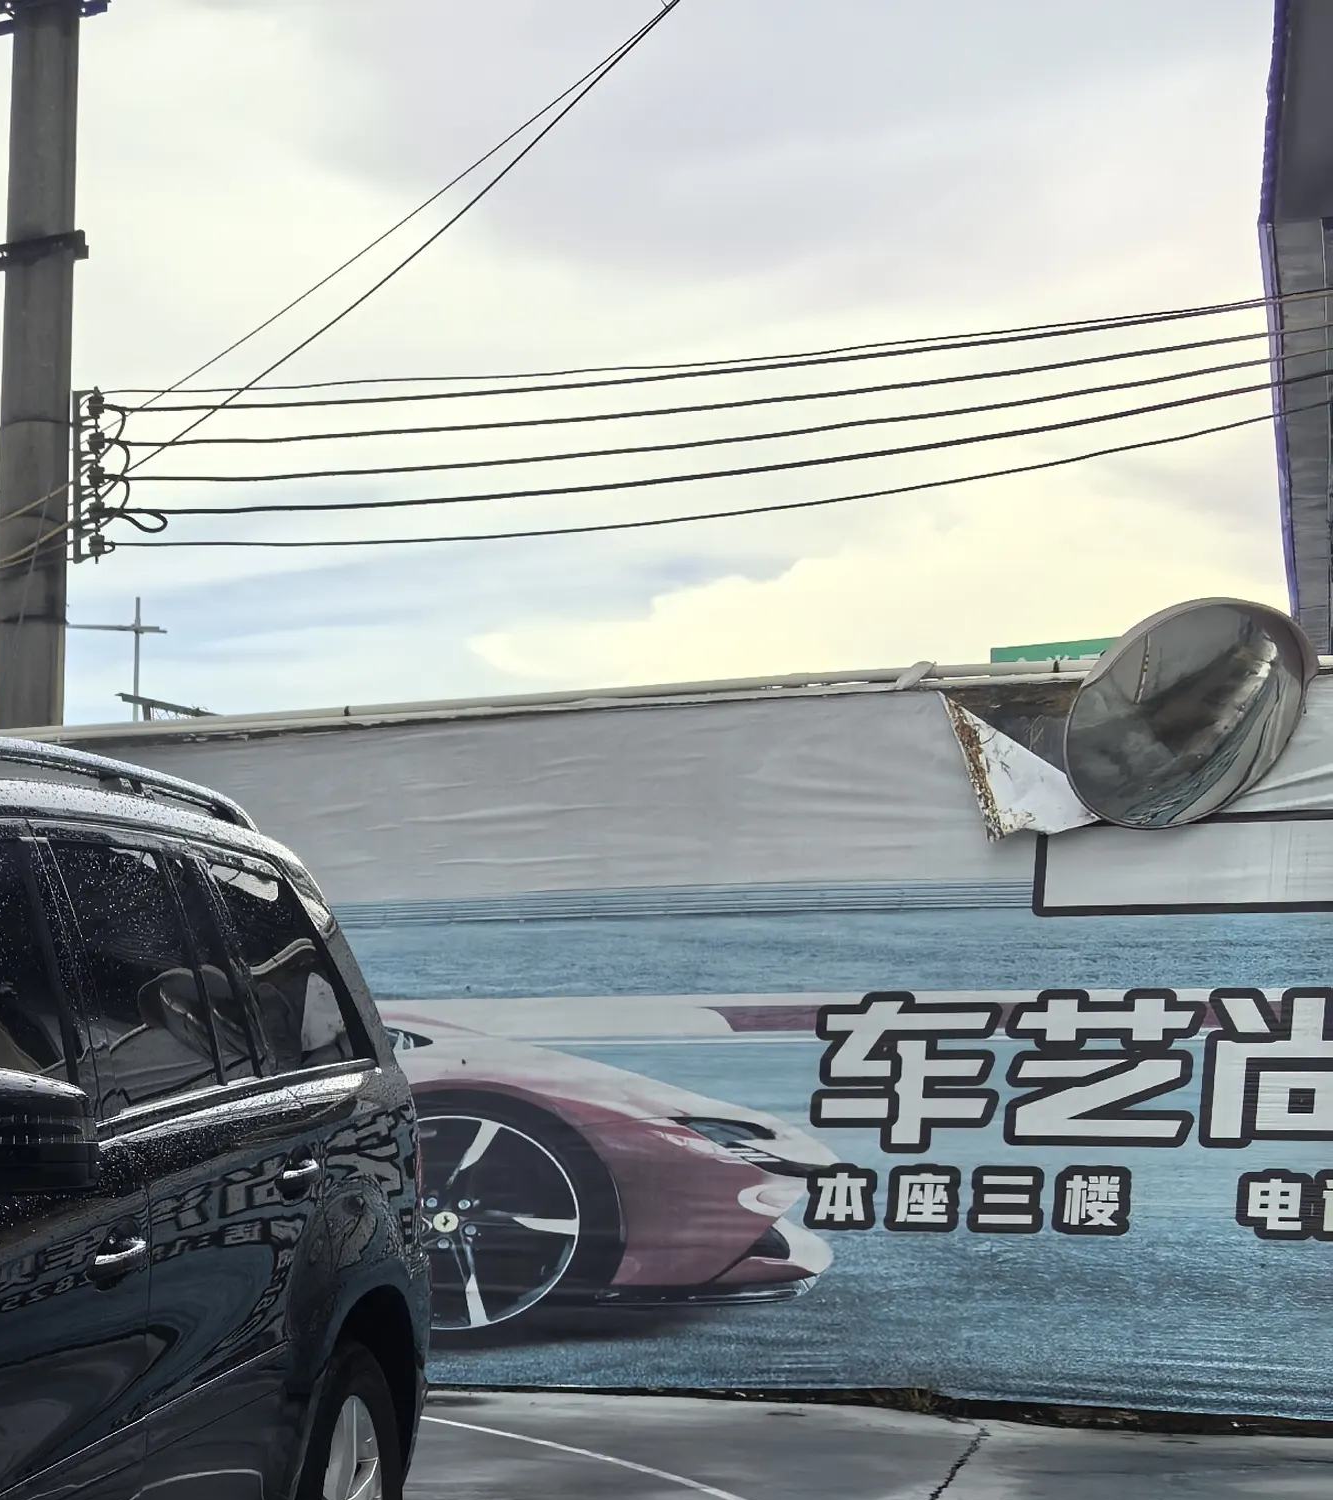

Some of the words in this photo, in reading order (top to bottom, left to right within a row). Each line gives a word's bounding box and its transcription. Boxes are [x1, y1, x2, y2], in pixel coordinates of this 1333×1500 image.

[812, 991, 1333, 1150] 车艺尚
[811, 1168, 1126, 1231] 本座三楼
[1241, 1173, 1333, 1236] 电
